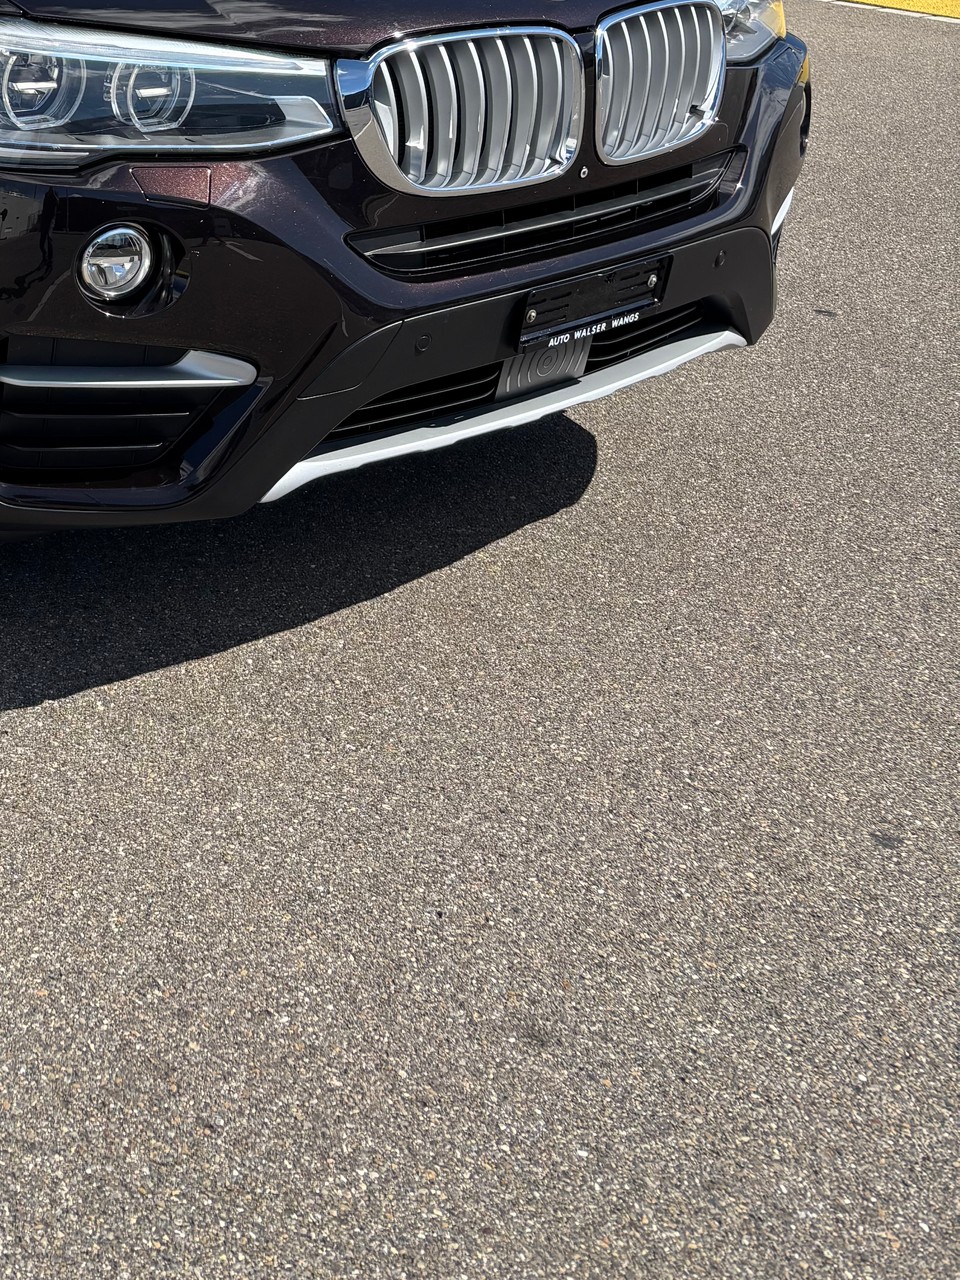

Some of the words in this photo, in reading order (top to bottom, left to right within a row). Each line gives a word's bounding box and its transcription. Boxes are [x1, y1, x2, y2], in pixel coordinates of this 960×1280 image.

[548, 334, 570, 347] AUTO
[574, 322, 606, 339] WALSER
[611, 312, 640, 328] WANGS
